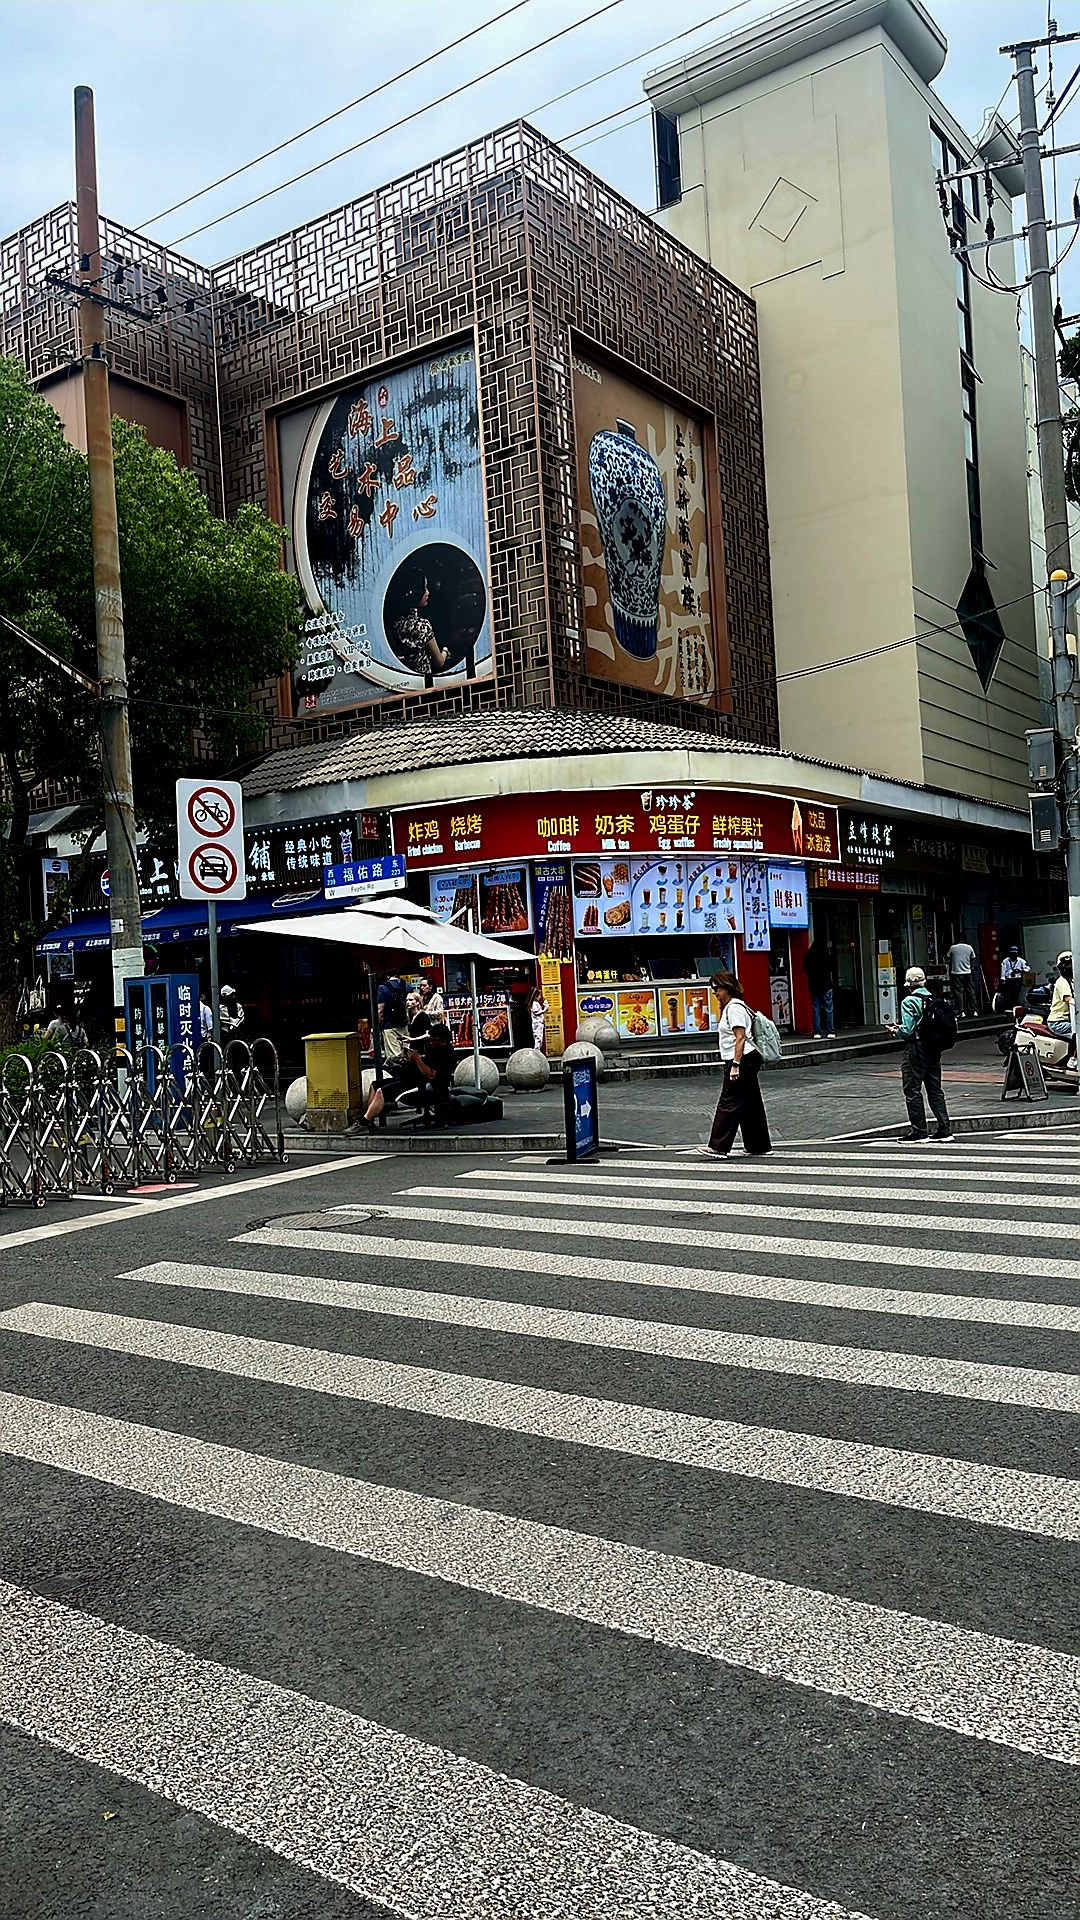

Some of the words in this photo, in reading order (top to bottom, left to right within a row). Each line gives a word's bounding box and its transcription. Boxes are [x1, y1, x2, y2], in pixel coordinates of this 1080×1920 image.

[348, 398, 399, 448] 海上
[328, 449, 416, 497] 艺术品
[318, 491, 438, 538] 交易中心
[655, 794, 694, 810] 珍珍茶
[408, 820, 440, 842] 炸鸡
[450, 814, 482, 836] 烧烤
[537, 815, 580, 838] 咖啡
[595, 815, 635, 835] 奶茶
[649, 814, 700, 835] 鸡蛋仔
[712, 815, 764, 836] 鲜榨果汁
[808, 811, 826, 829] 饮品
[284, 836, 332, 854] 经典小吃
[547, 840, 571, 852] Coffee
[658, 837, 671, 850] Egg
[286, 852, 333, 871] 传统味道
[327, 869, 335, 879] 西
[343, 863, 383, 883] 福佑路
[391, 859, 399, 868] 东
[535, 866, 565, 876] 蒙古大串
[328, 889, 336, 897] W
[350, 885, 366, 893] Fuyou
[394, 879, 399, 887] E
[774, 889, 803, 909] 出餐口
[595, 970, 618, 979] 鸡蛋仔
